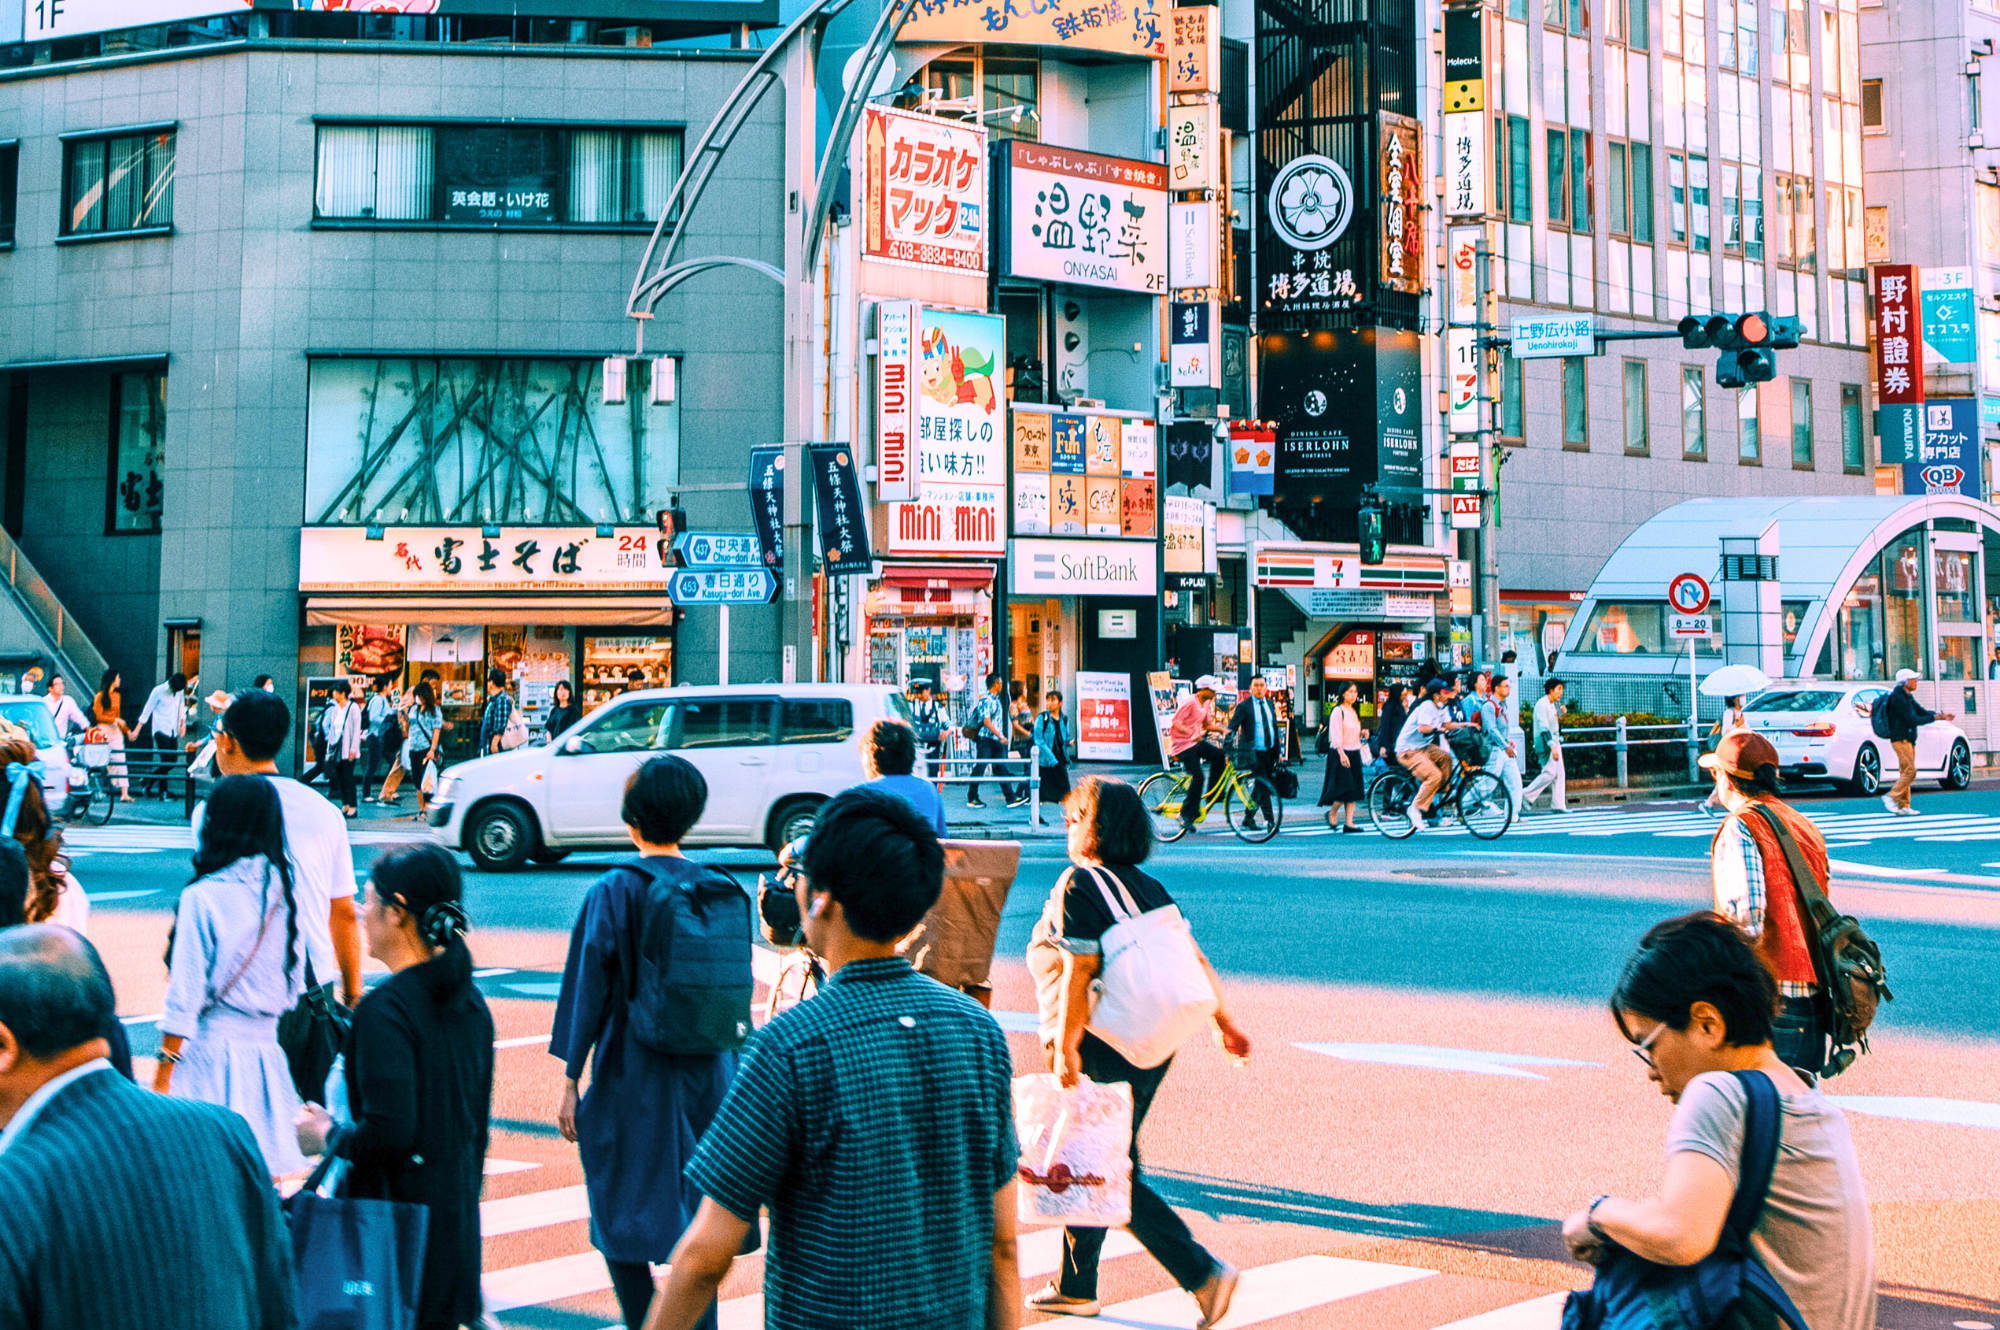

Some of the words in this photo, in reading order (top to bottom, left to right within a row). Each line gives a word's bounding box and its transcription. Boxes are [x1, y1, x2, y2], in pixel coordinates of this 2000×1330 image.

[888, 136, 979, 190] カラオケ
[889, 188, 959, 236] マック
[1387, 133, 1405, 276] 全室個室
[961, 206, 980, 228] 24h
[900, 241, 980, 269] 03-3834-9400
[1184, 228, 1196, 280] SoftBank
[1063, 260, 1118, 281] ONYASAI
[1146, 273, 1165, 290] 2F
[1269, 269, 1357, 300] 博多道場
[1515, 320, 1589, 340] 上野広小路
[1881, 275, 1911, 395] 野村證券
[1527, 340, 1578, 351] Uenohirokoji
[884, 363, 905, 414] mini
[1383, 437, 1418, 450] ISERLOHN
[1903, 408, 1915, 459] NOMURA
[1284, 440, 1349, 451] ISERLOHN
[884, 432, 905, 482] mini
[1928, 467, 1956, 485] QB
[900, 503, 941, 541] mini
[956, 506, 995, 542] mini
[619, 535, 647, 551] 24
[695, 544, 709, 557] 437
[434, 537, 589, 576] 富士そば
[618, 553, 646, 568] 時間
[713, 552, 749, 563] Chuo-dori
[1061, 554, 1138, 581] SoftBank
[682, 581, 697, 593] 453
[705, 573, 760, 589] 春日通り
[702, 589, 745, 601] Kasuga-dori
[747, 589, 762, 599] Ave.
[1694, 619, 1706, 628] 20
